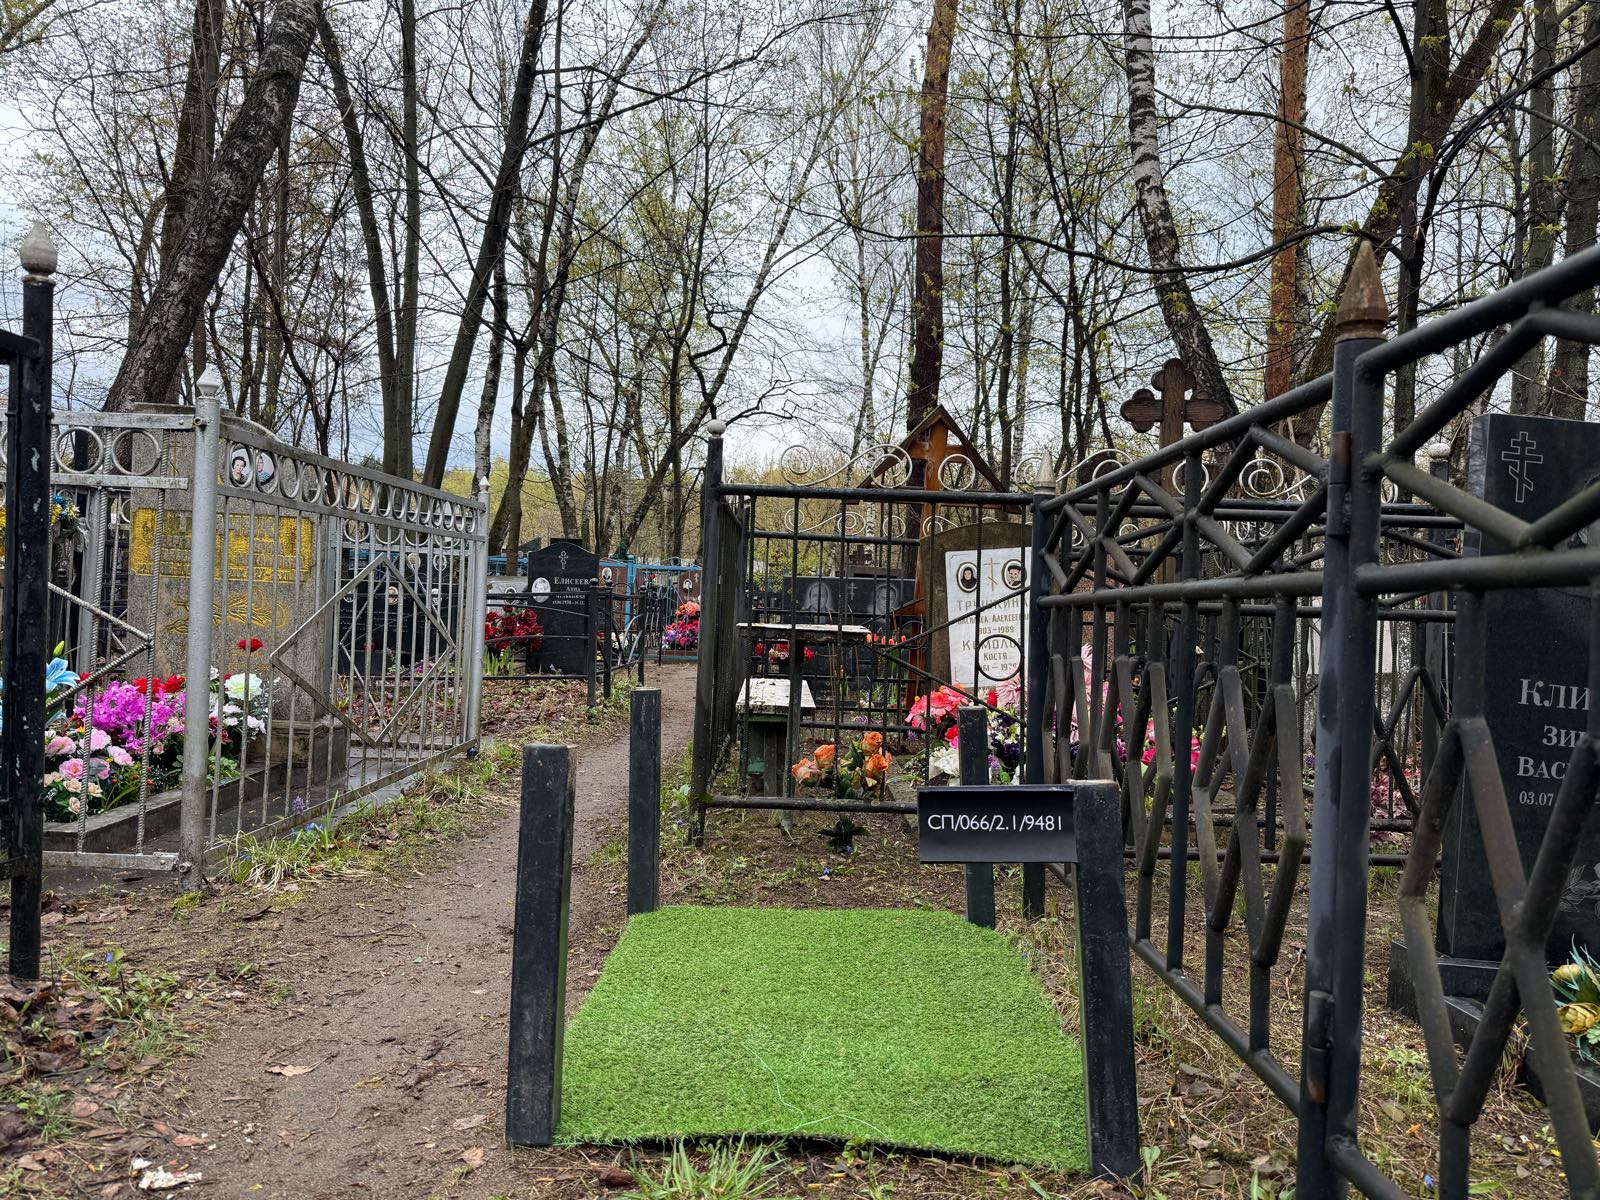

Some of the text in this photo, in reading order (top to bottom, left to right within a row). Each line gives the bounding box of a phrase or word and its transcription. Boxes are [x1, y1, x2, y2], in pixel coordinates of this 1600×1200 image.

[554, 577, 591, 585] ЕЛИСЕЕВ
[1518, 678, 1590, 711] КЛИ
[1517, 756, 1571, 780] ВАС
[1519, 791, 1554, 807] 03.07
